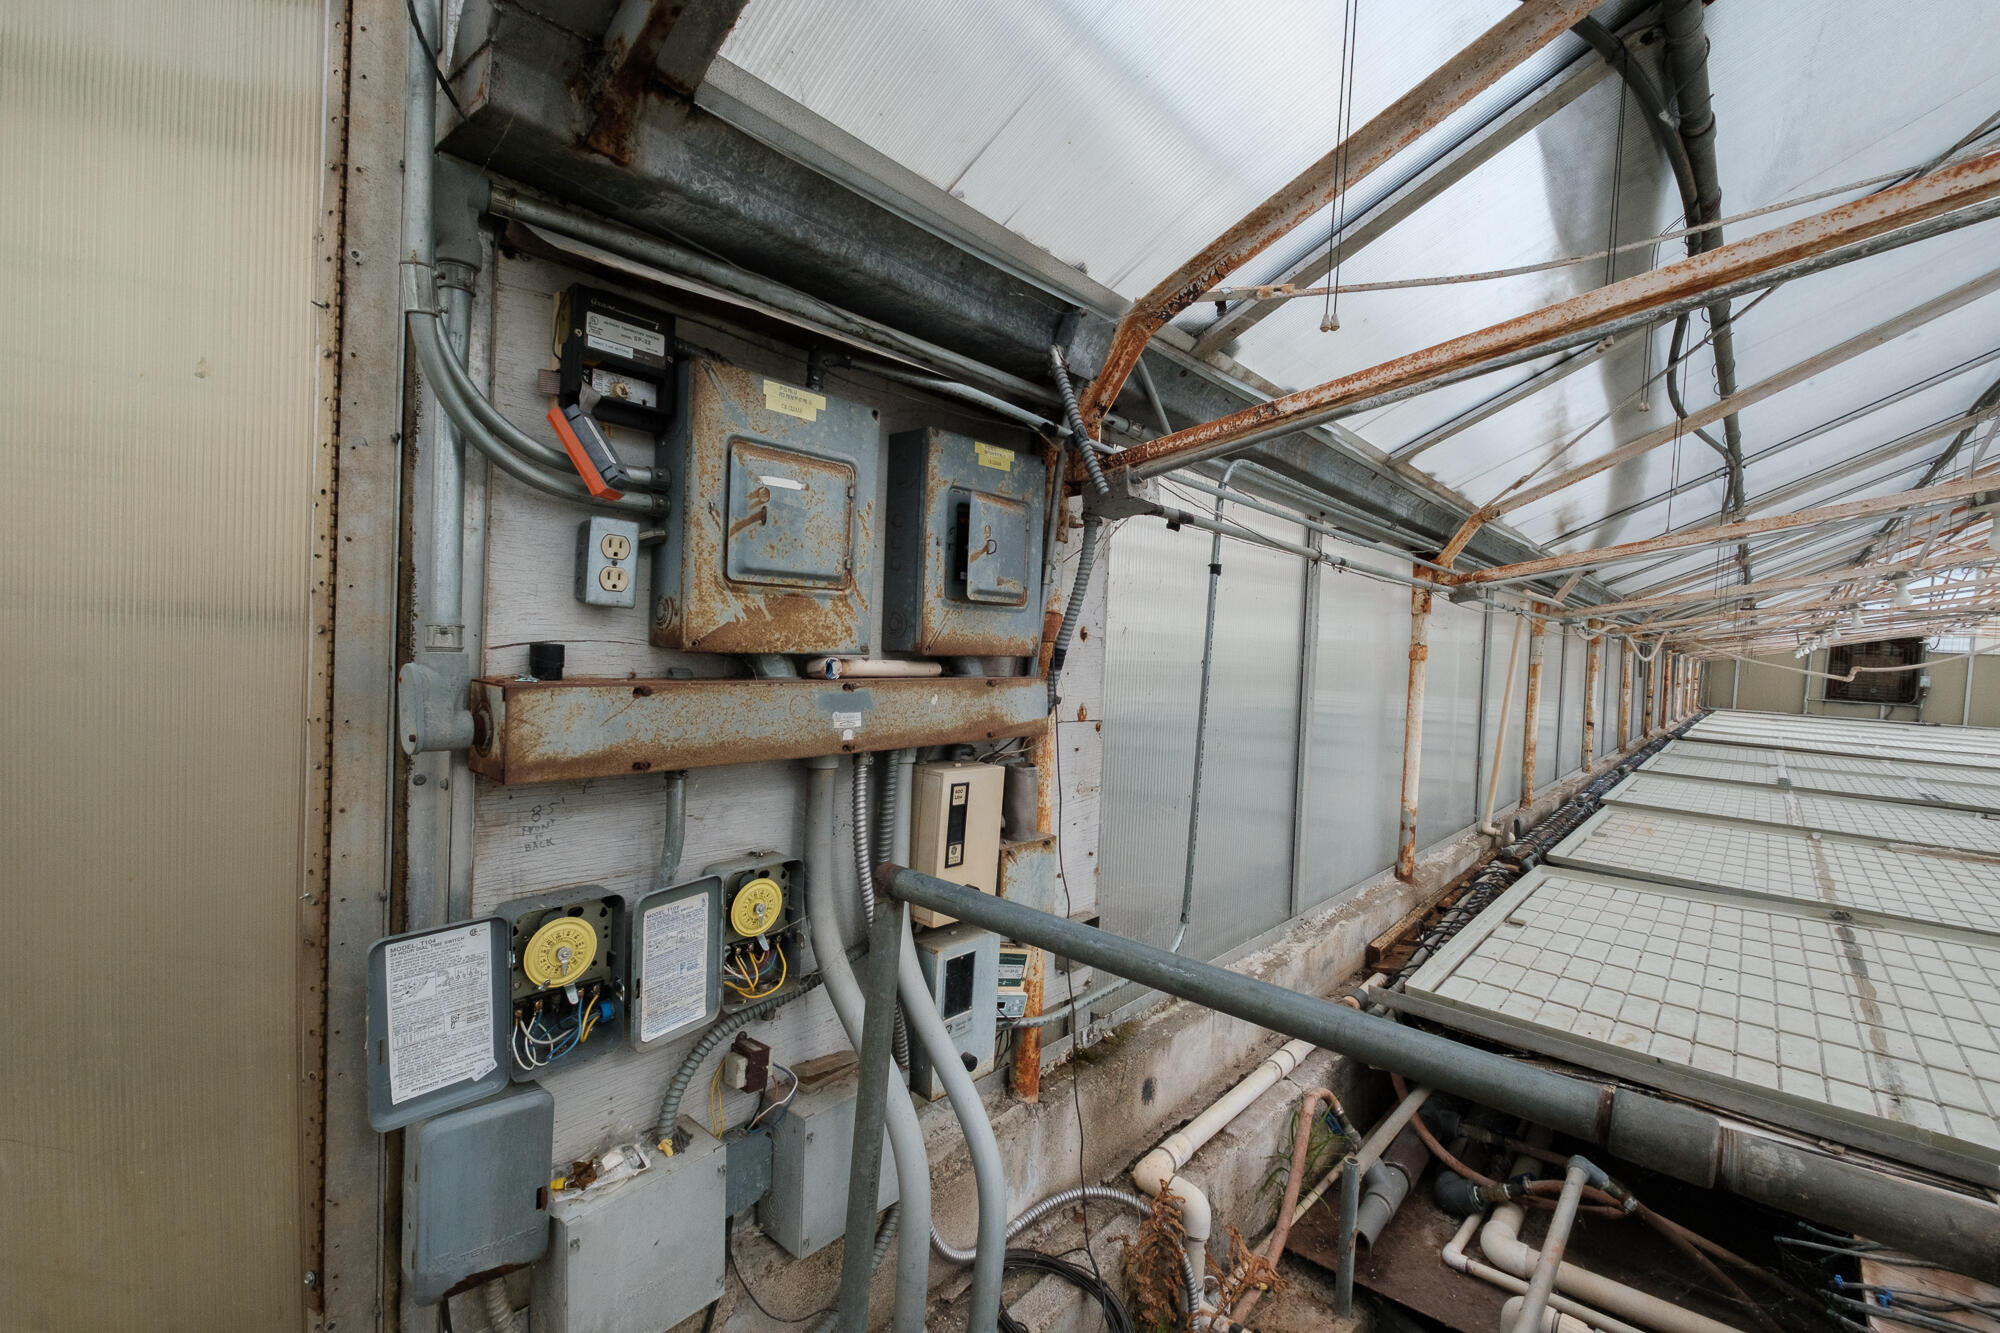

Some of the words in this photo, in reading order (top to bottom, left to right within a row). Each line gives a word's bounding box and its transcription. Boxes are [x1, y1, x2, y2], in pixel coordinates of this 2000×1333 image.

[524, 838, 556, 852] BACK
[390, 943, 416, 953] MODEL
[420, 938, 437, 946] T104
